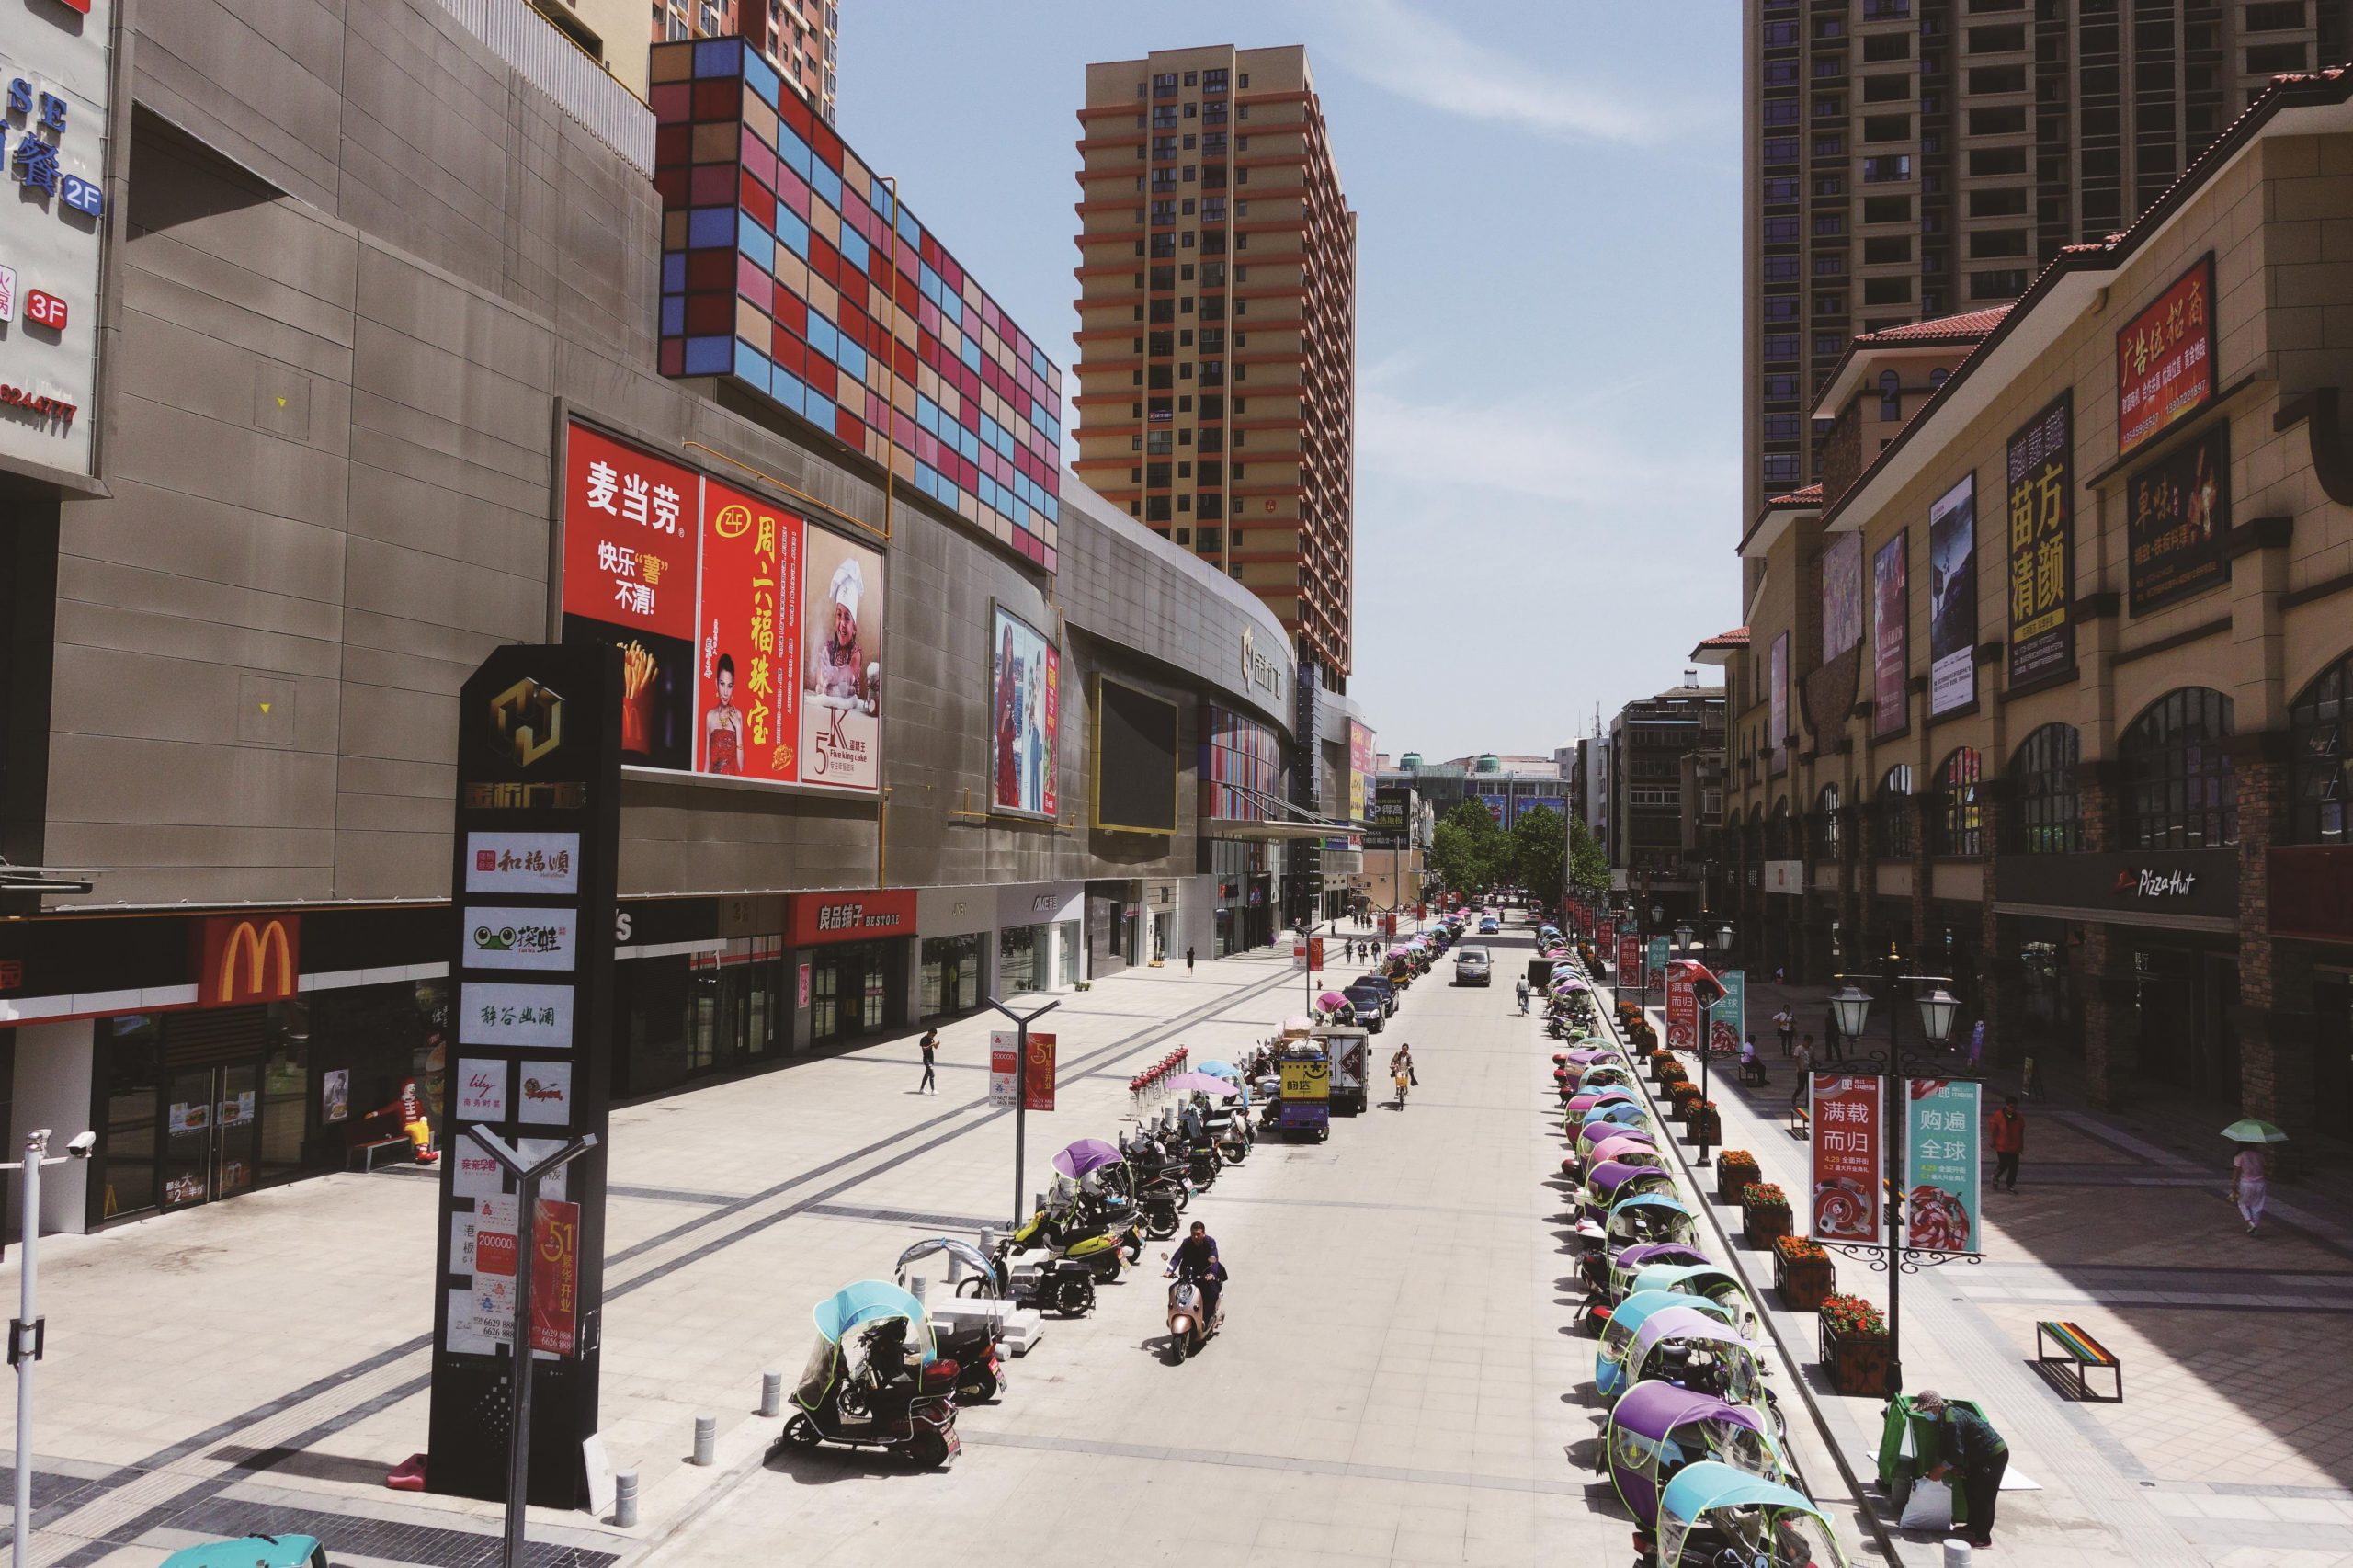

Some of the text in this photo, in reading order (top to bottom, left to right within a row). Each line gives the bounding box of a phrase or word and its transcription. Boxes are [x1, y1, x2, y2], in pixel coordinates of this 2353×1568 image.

[0, 119, 63, 198] 餐
[66, 179, 100, 209] 2F
[31, 294, 65, 323] 3F
[746, 515, 776, 746] 周六福珠宝
[830, 749, 867, 763] Five king cake
[1382, 804, 1403, 815] 得高
[2138, 869, 2195, 897] Pizza Hut
[820, 904, 862, 931] 良品铺子
[865, 915, 900, 926] BESTORE
[1671, 983, 1692, 993] 满载
[1671, 996, 1693, 1006] 而归
[1716, 998, 1738, 1009] 全球
[1346, 1054, 1360, 1069] 5K
[1824, 1102, 1869, 1123] 满载
[1920, 1110, 1966, 1131] 购遍
[1824, 1131, 1868, 1153] 而归
[1920, 1139, 1967, 1161] 全球
[560, 1254, 573, 1312] 繁华开业
[483, 1317, 501, 1327] 6629
[483, 1326, 500, 1336] 6626
[542, 1328, 558, 1337] 6629
[541, 1337, 557, 1347] 6626
